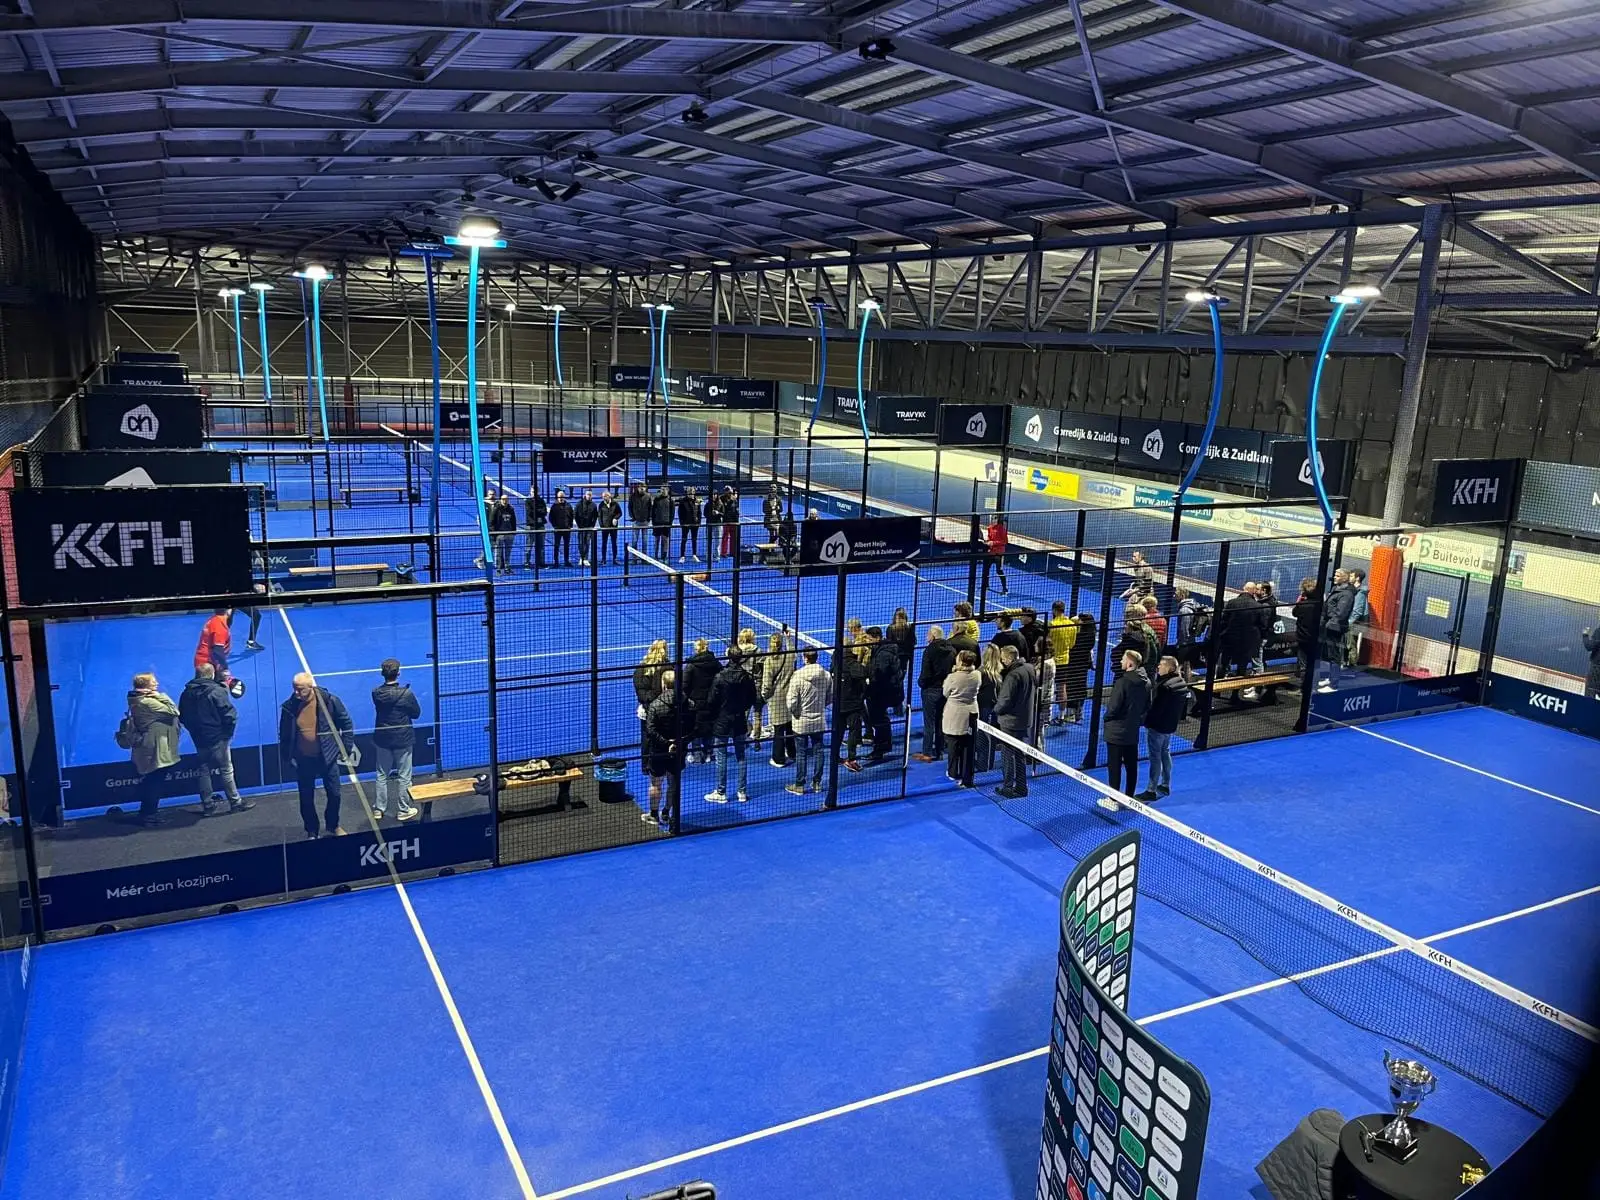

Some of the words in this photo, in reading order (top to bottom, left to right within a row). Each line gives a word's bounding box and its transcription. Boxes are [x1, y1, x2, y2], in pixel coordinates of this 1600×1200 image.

[1093, 431, 1130, 445] Zuidlaen
[1433, 549, 1480, 568] Buiteveld
[106, 884, 144, 899] Méér
[146, 882, 174, 893] dan
[177, 873, 234, 888] kozijnen.
